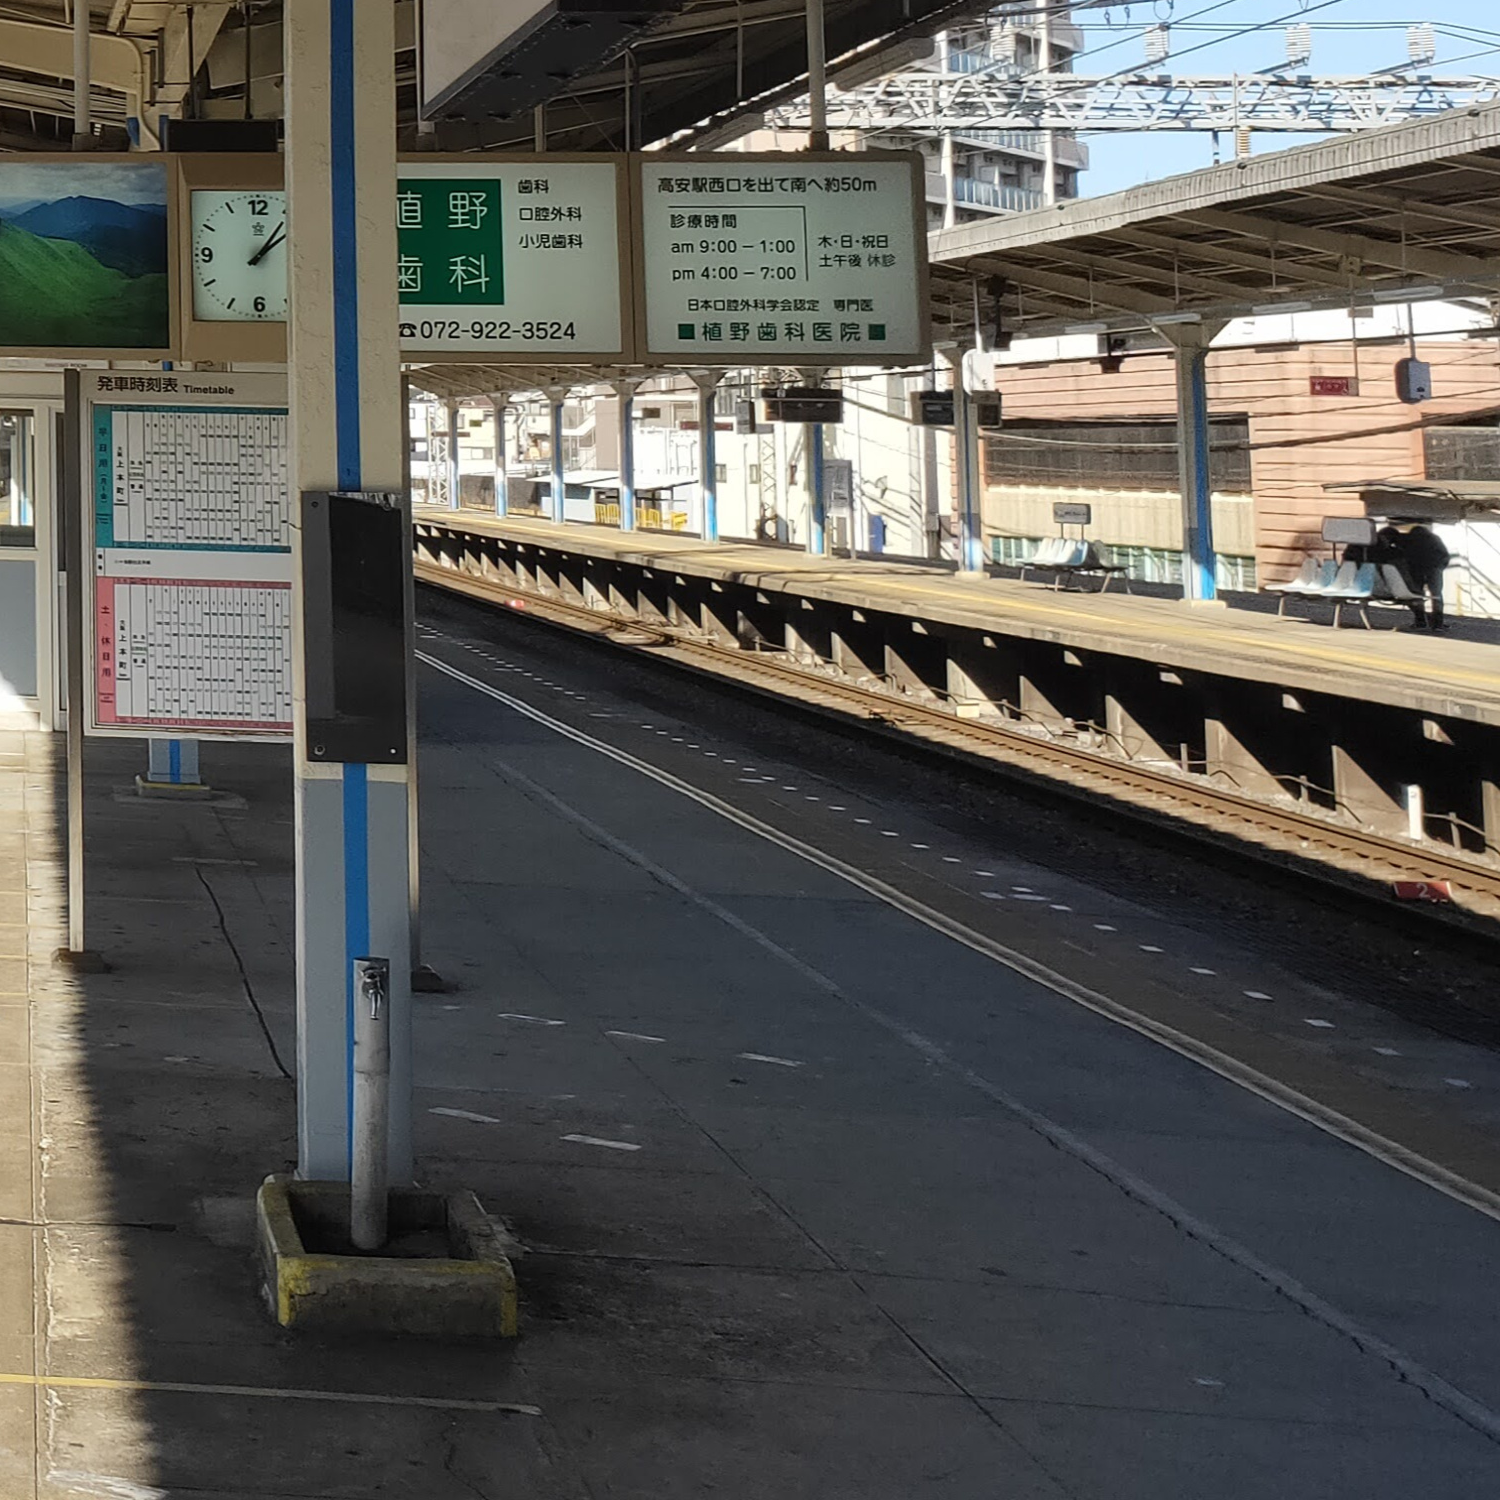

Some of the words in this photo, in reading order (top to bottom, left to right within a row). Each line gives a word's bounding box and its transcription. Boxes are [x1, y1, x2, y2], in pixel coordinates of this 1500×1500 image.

[518, 179, 549, 194] 歯科
[658, 177, 877, 193] 高安駅西口を出て南へ約50m
[248, 200, 268, 216] 12
[519, 206, 582, 222] 口腔外科
[670, 214, 737, 229] 診療時間
[519, 234, 583, 249] 小児歯科
[671, 243, 694, 253] am
[700, 240, 737, 253] 9:00
[760, 240, 795, 253] 1:00
[818, 235, 889, 249] 木・日・祝日
[202, 247, 213, 264] 9
[819, 254, 862, 268] 土午後
[867, 254, 896, 268] 休診
[672, 269, 695, 281] pm
[701, 267, 738, 280] 4:00
[760, 267, 796, 280] 7:00
[253, 296, 265, 313] 6
[687, 299, 820, 312] 日本口腔外科学会認定
[833, 299, 874, 312] 専門医
[421, 321, 576, 340] 072-922-3524
[702, 322, 861, 342] 植野歯科医院
[97, 376, 178, 393] 発車時刻表
[184, 385, 235, 395] Timetable
[1416, 883, 1430, 898] 2
